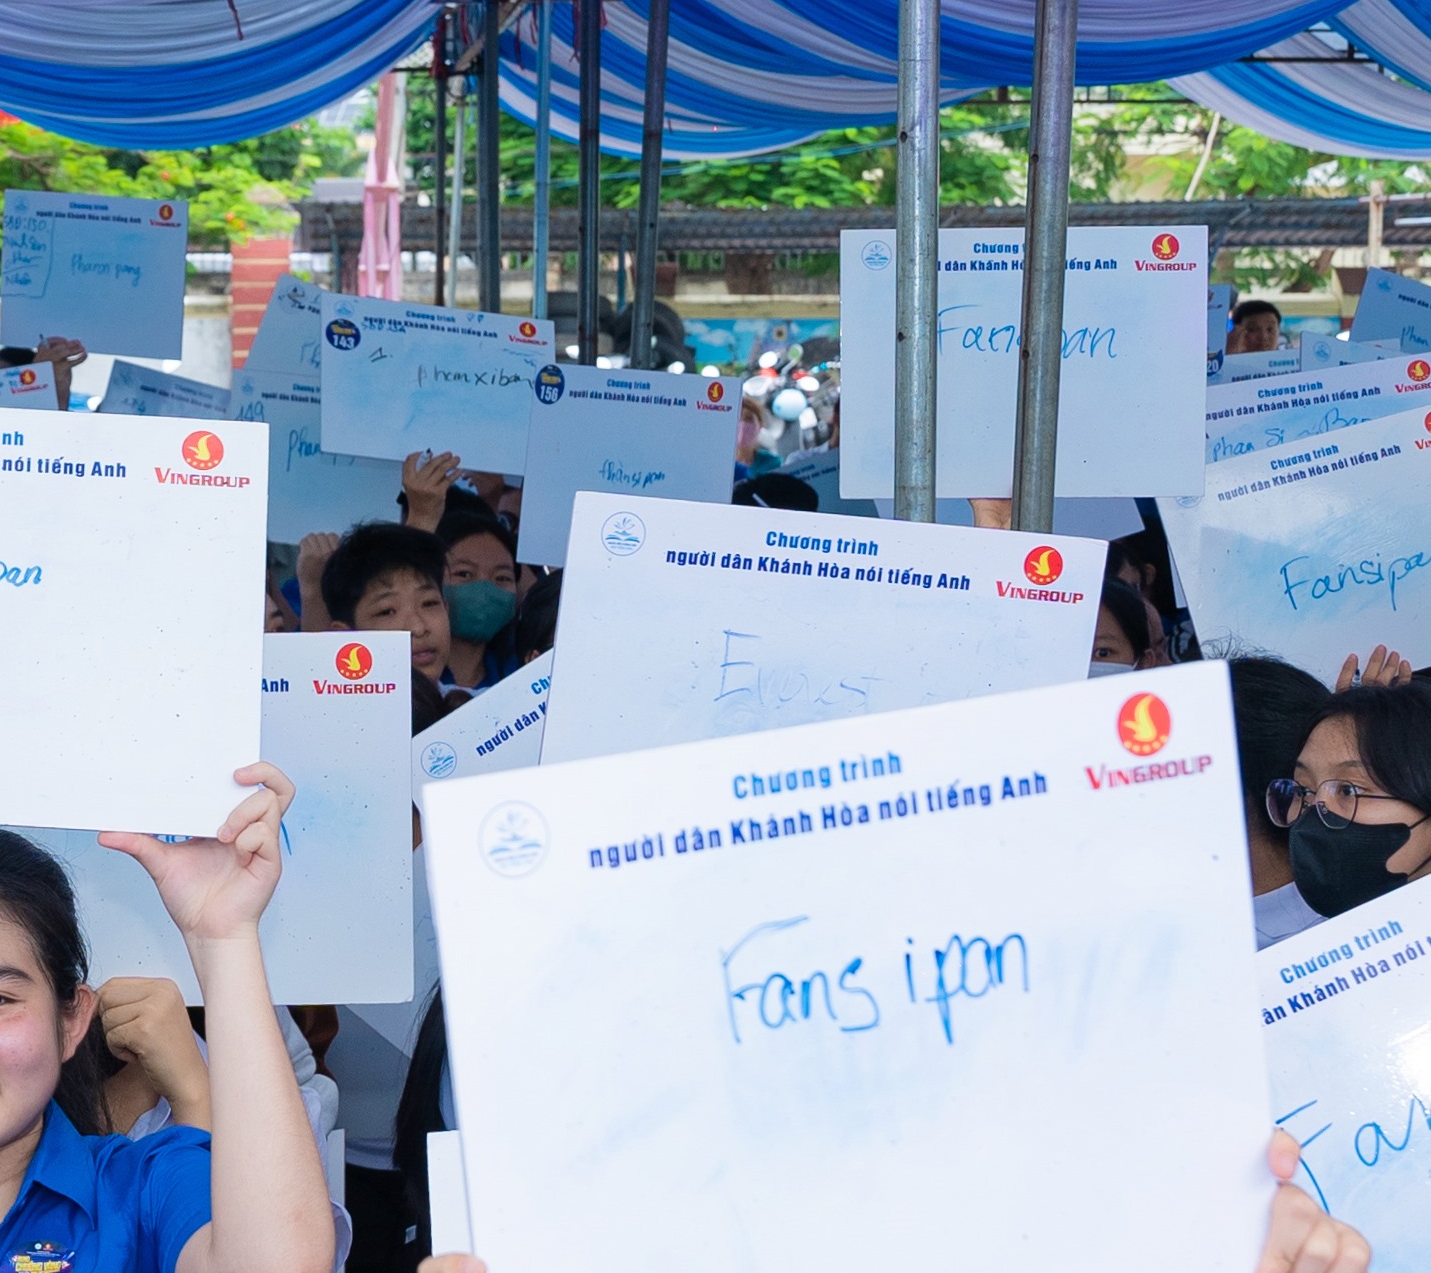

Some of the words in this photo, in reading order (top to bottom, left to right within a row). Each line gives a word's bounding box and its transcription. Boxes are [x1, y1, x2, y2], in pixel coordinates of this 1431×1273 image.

[1134, 259, 1197, 271] VINGROUP
[333, 335, 356, 350] 143
[1, 456, 31, 472] nói
[36, 456, 85, 477] tiếng
[90, 460, 126, 478] Anh
[153, 466, 250, 488] VINGROUP
[995, 580, 1084, 604] VINGROUP
[312, 677, 396, 695] VINGROUP
[732, 765, 832, 799] Chương
[839, 751, 902, 782] trình
[1084, 754, 1212, 790] VINGROUP
[589, 833, 664, 868] người
[673, 827, 722, 854] dân
[729, 810, 813, 845] Khánh
[820, 803, 870, 830] Hòa
[878, 791, 918, 820] nói
[925, 783, 992, 812] tiếng
[1000, 771, 1047, 799] Anh
